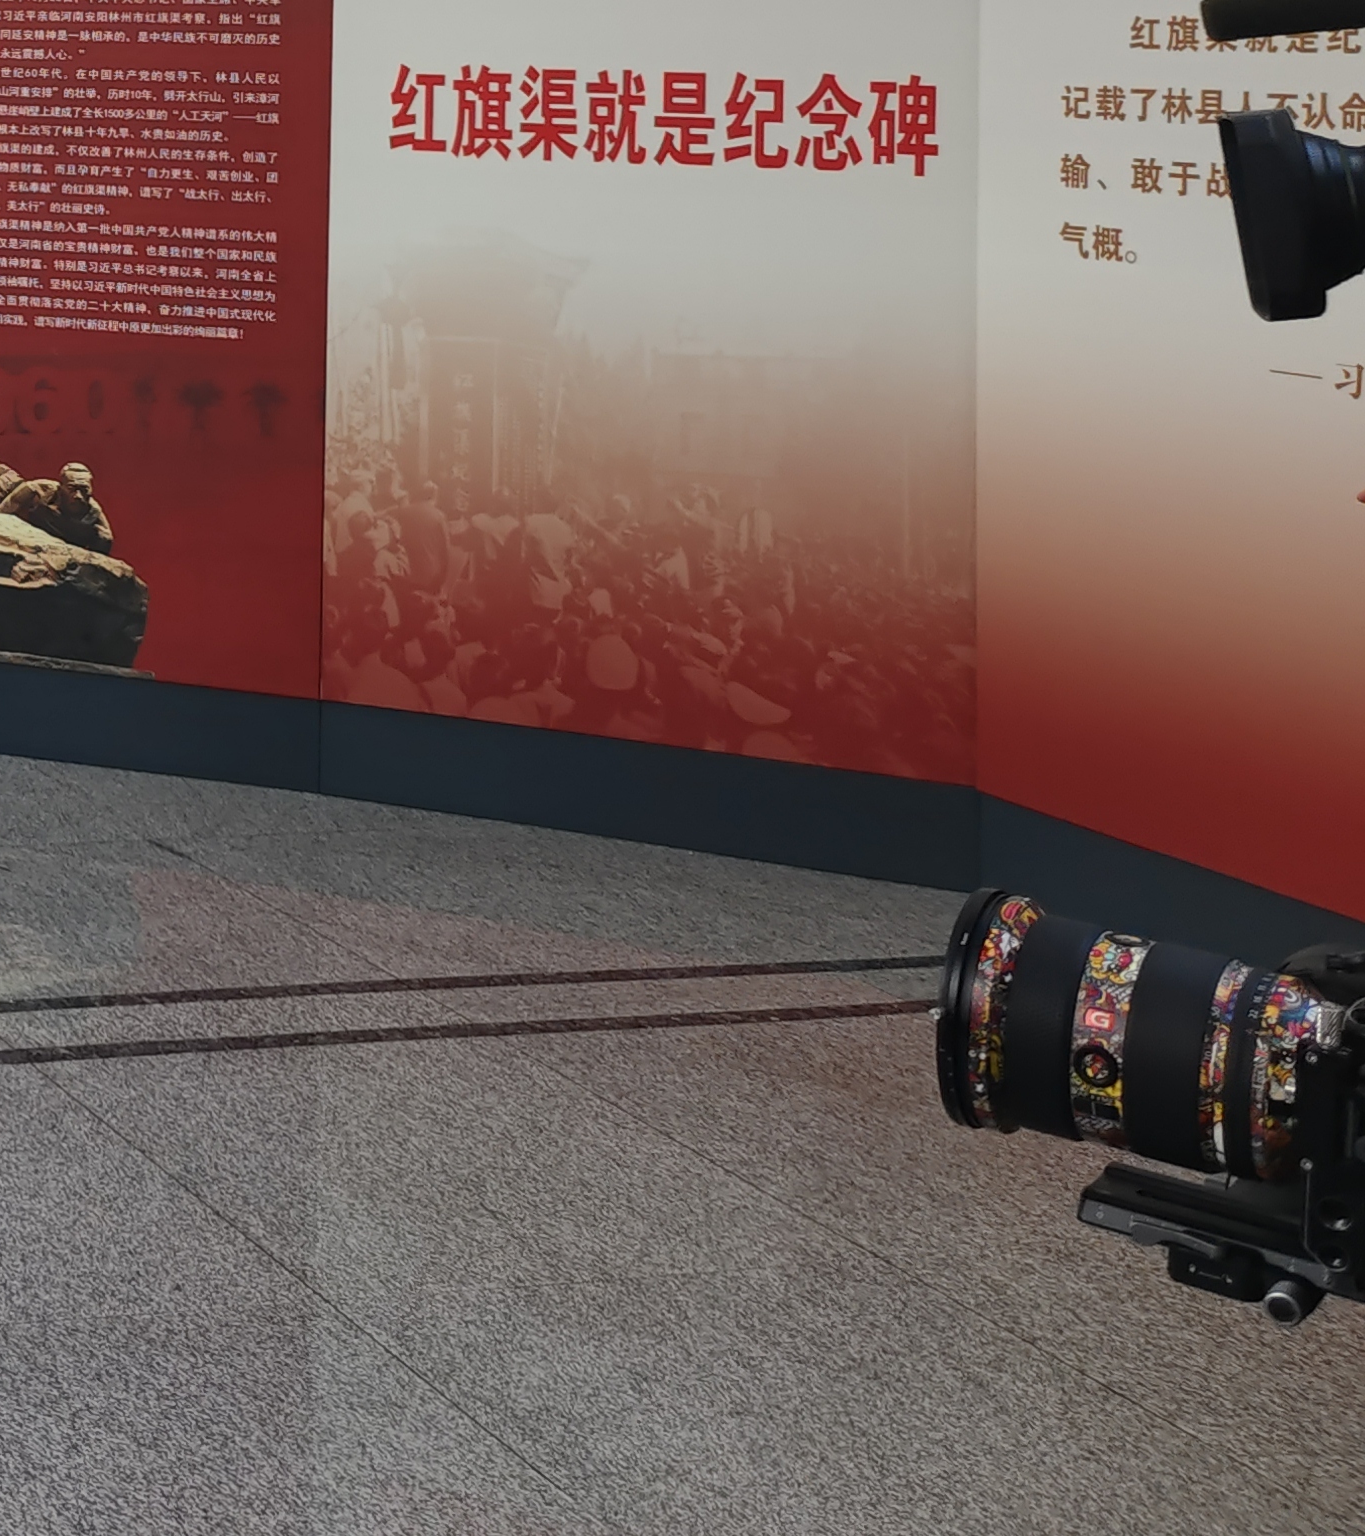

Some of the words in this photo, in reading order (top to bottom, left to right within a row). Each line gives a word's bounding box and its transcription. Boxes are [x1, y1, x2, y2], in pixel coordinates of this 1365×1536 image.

[389, 64, 939, 176] 红旗渠就是纪念碑
[1059, 221, 1137, 263] 气概。
